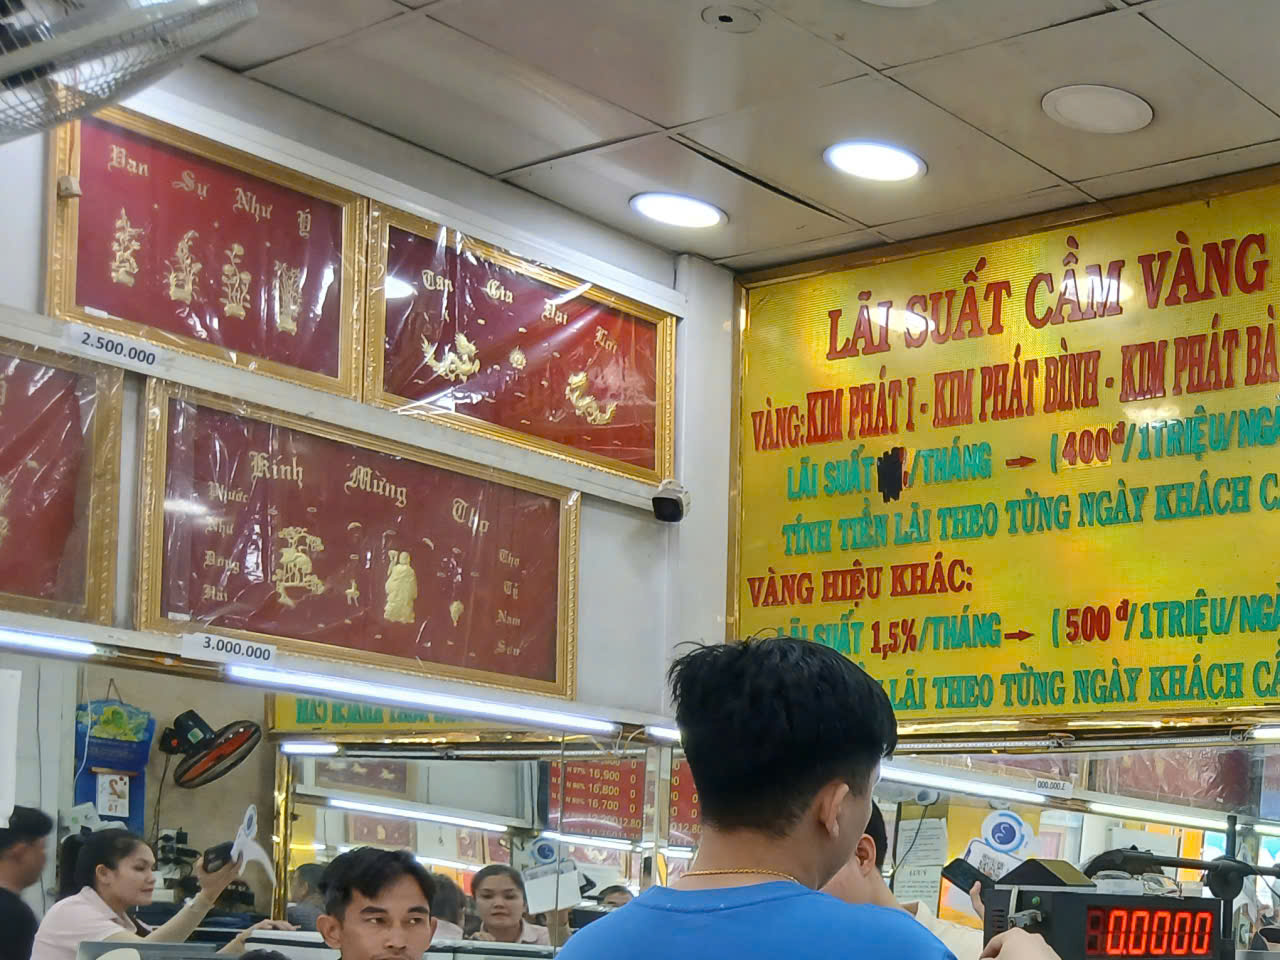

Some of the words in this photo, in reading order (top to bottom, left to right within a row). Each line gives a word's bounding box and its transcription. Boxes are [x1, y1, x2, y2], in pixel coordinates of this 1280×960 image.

[827, 290, 893, 360] LÃI
[904, 257, 1012, 348] SUẤT
[1026, 235, 1126, 329] CẦM
[1138, 230, 1270, 309] VÀNG
[81, 331, 156, 366] 2.500.000
[849, 365, 902, 440] PHÁT
[933, 368, 975, 429] KIM
[979, 343, 1039, 422] PHÁT
[1043, 337, 1100, 413] BÌNH
[1119, 340, 1168, 402] KIM
[1172, 313, 1239, 396] PHÁT
[1245, 304, 1280, 386] BÀ
[787, 456, 818, 500] LÃI
[823, 444, 875, 496] SUẤT
[782, 513, 833, 556] TÍNH
[838, 497, 889, 551] TIỀN
[894, 502, 931, 545] LÃI
[937, 502, 998, 540] THEO
[1005, 488, 1072, 535] TỪNG
[1078, 479, 1149, 528] NGÀY
[1154, 468, 1252, 521] KHÁCH
[747, 566, 815, 607] VÀNG
[821, 559, 884, 608] HIỆU
[890, 552, 973, 597] KHÁC:
[202, 636, 271, 661] 3.000.000
[889, 668, 927, 710] LÃI
[931, 673, 994, 710] THEO
[1000, 662, 1066, 707] TỪNG
[1073, 657, 1143, 705] NGÀY
[1148, 653, 1244, 701] KHÁCH
[588, 783, 620, 796] 16,800
[630, 789, 636, 799] 0
[589, 768, 620, 782] 16,900
[630, 775, 637, 784] 0
[588, 798, 619, 811] 16,700
[629, 804, 636, 814] 0
[619, 816, 641, 828] 12,80
[1106, 908, 1214, 956] 0.0000
